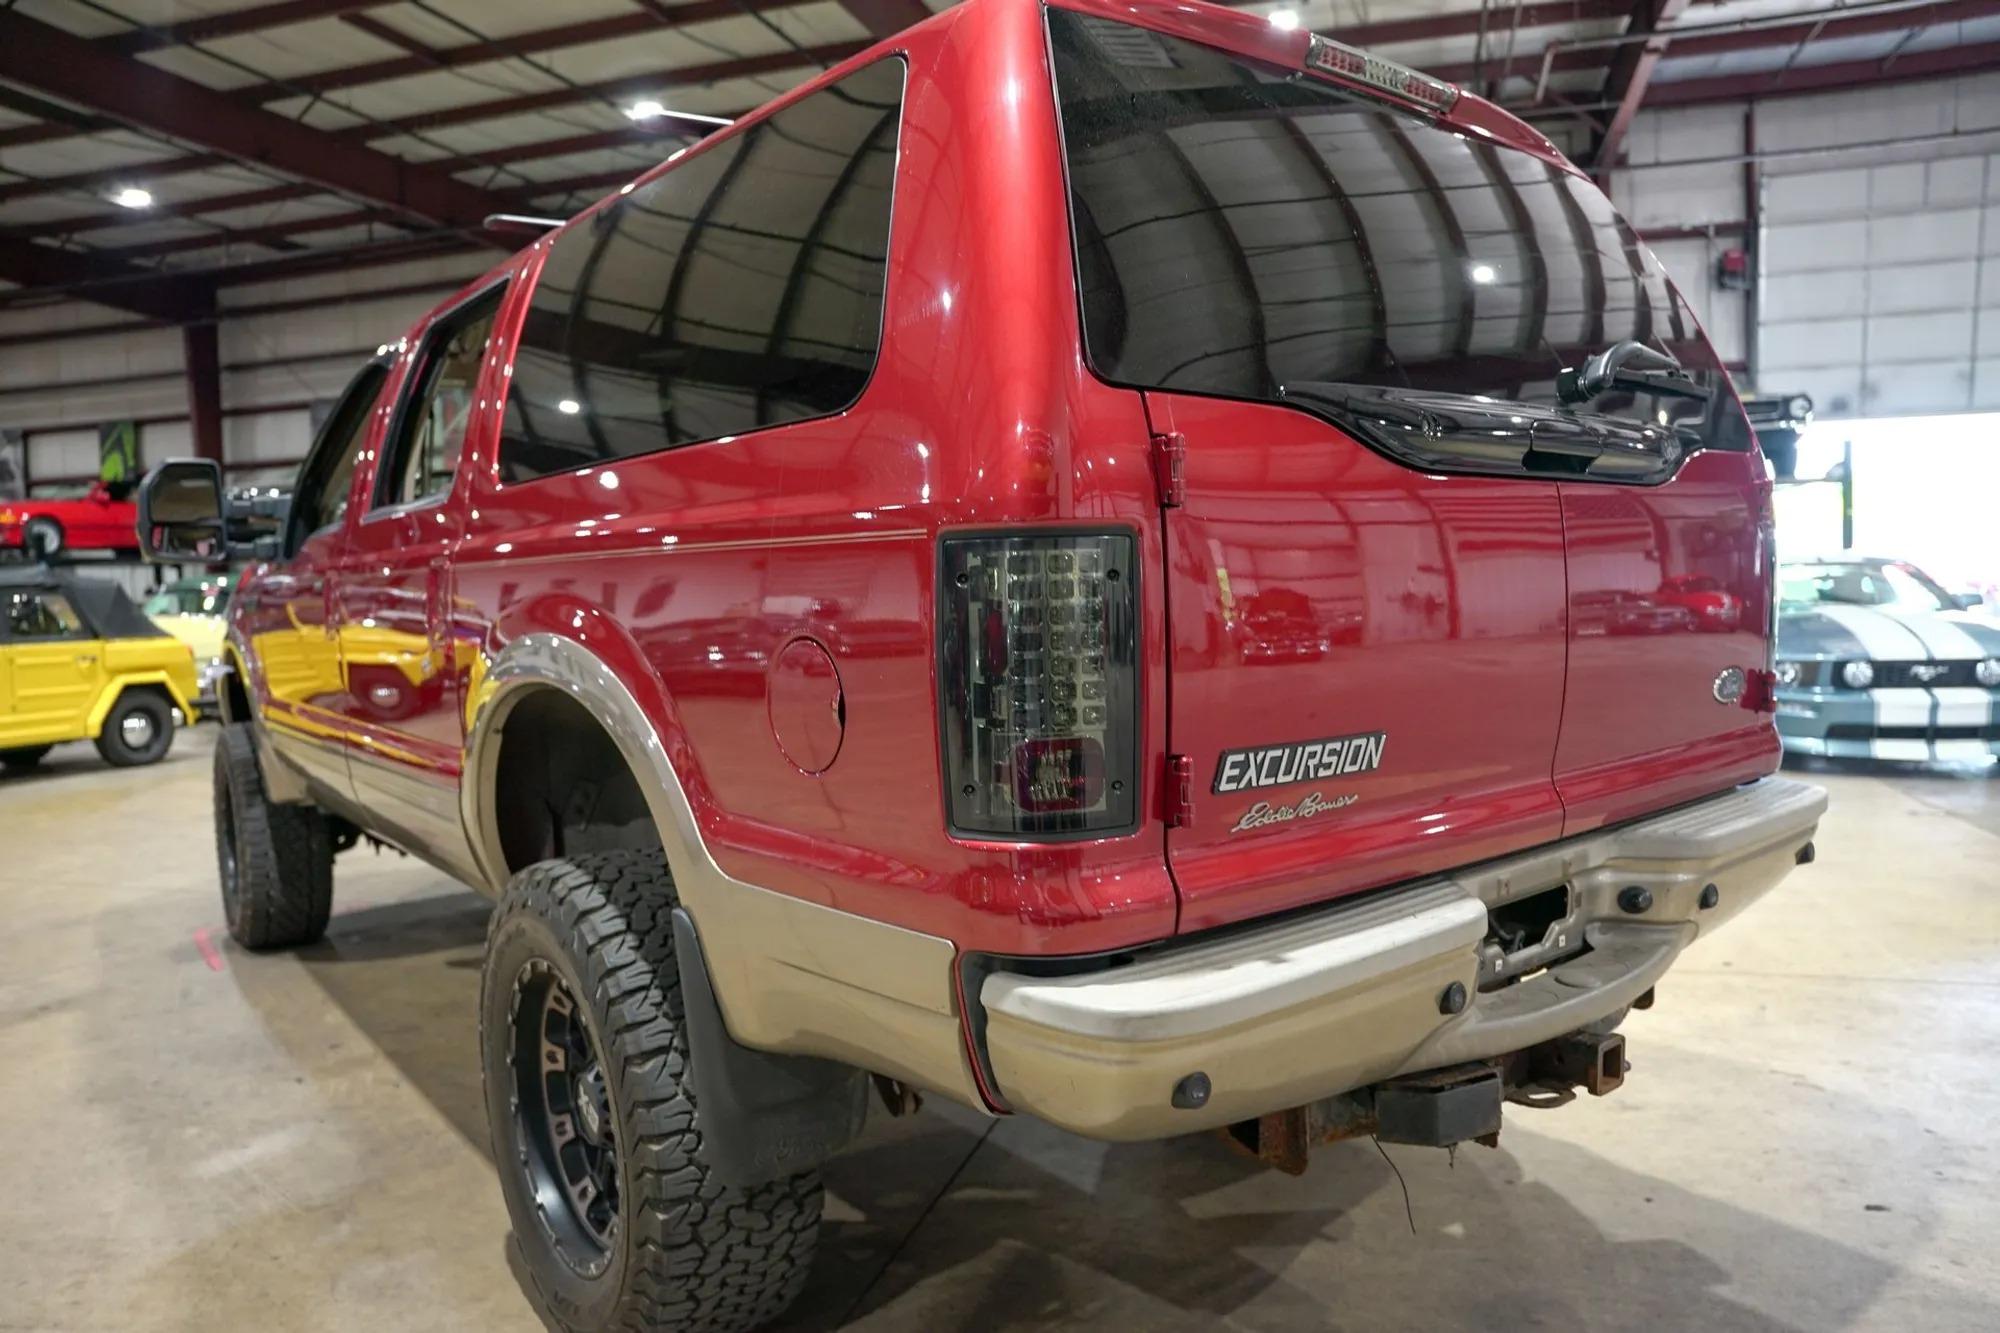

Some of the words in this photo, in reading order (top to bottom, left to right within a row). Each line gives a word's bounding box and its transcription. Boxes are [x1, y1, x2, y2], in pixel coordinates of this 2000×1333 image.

[1218, 734, 1387, 792] EXCURSION
[1231, 801, 1295, 833] Eddie
[1294, 792, 1358, 817] Bauer
